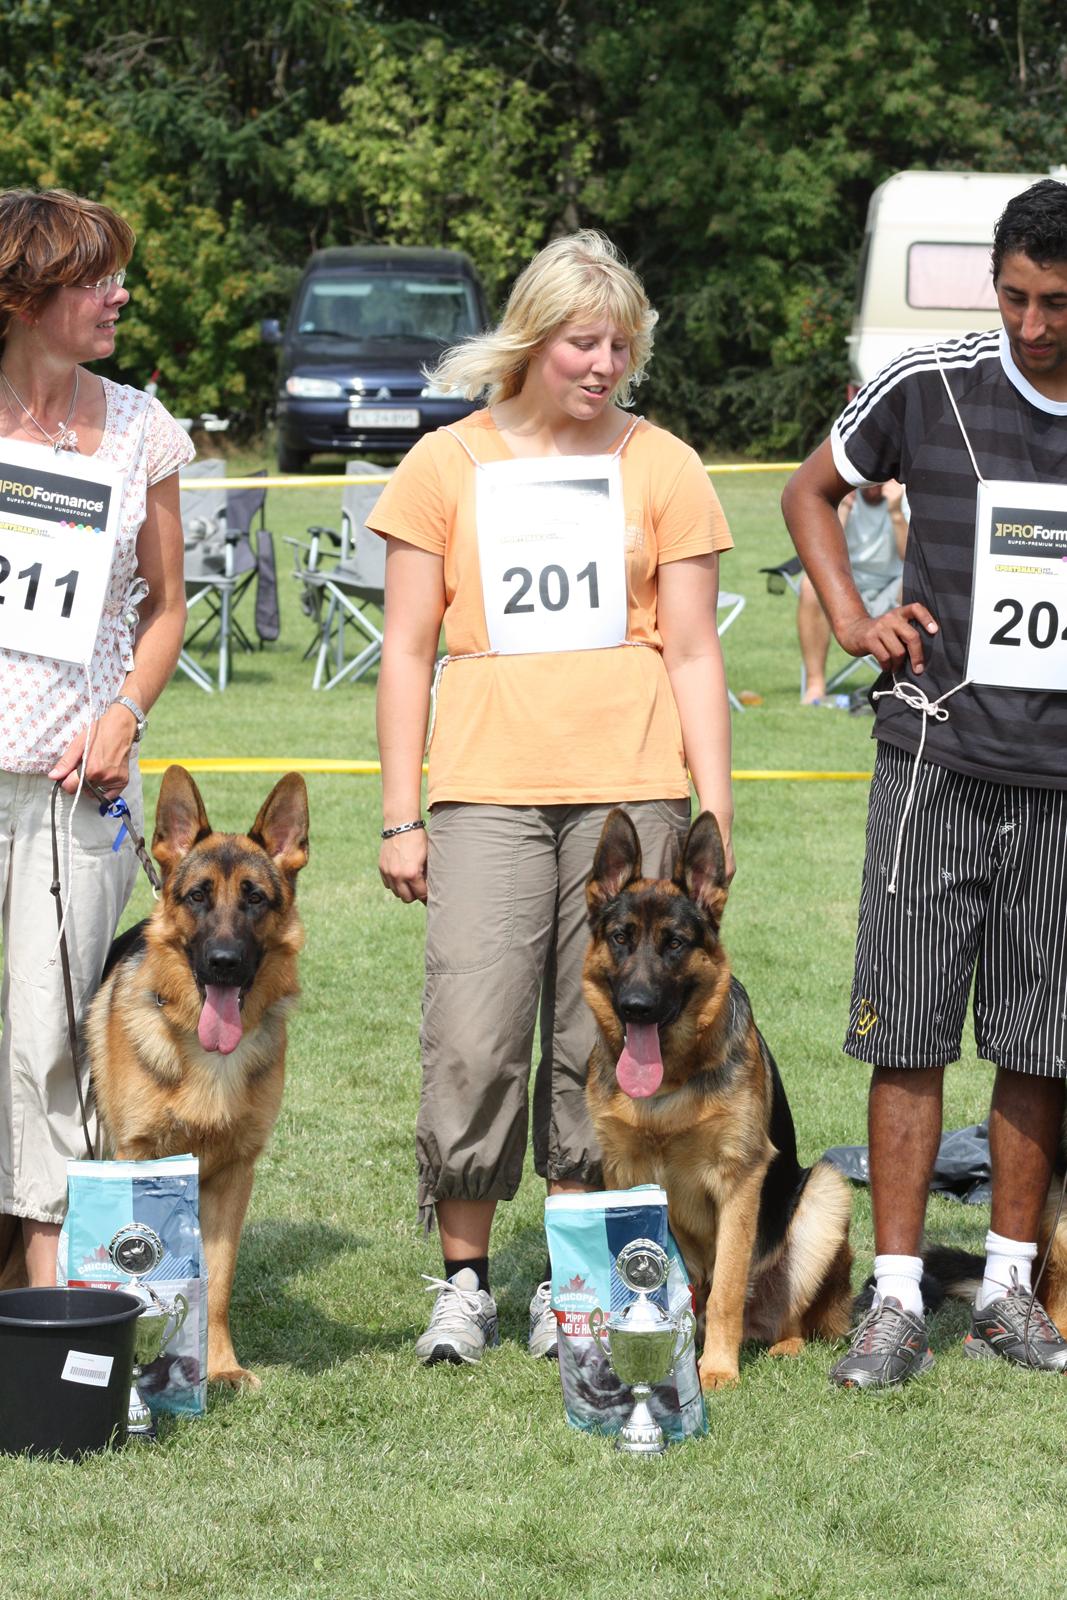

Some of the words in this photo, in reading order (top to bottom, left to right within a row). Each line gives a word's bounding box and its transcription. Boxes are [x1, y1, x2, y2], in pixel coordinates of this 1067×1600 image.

[6, 497, 53, 510] SUPER-PREMIUM
[502, 561, 599, 614] 201
[989, 598, 1067, 650] 20
[565, 1313, 586, 1323] PUPPY
